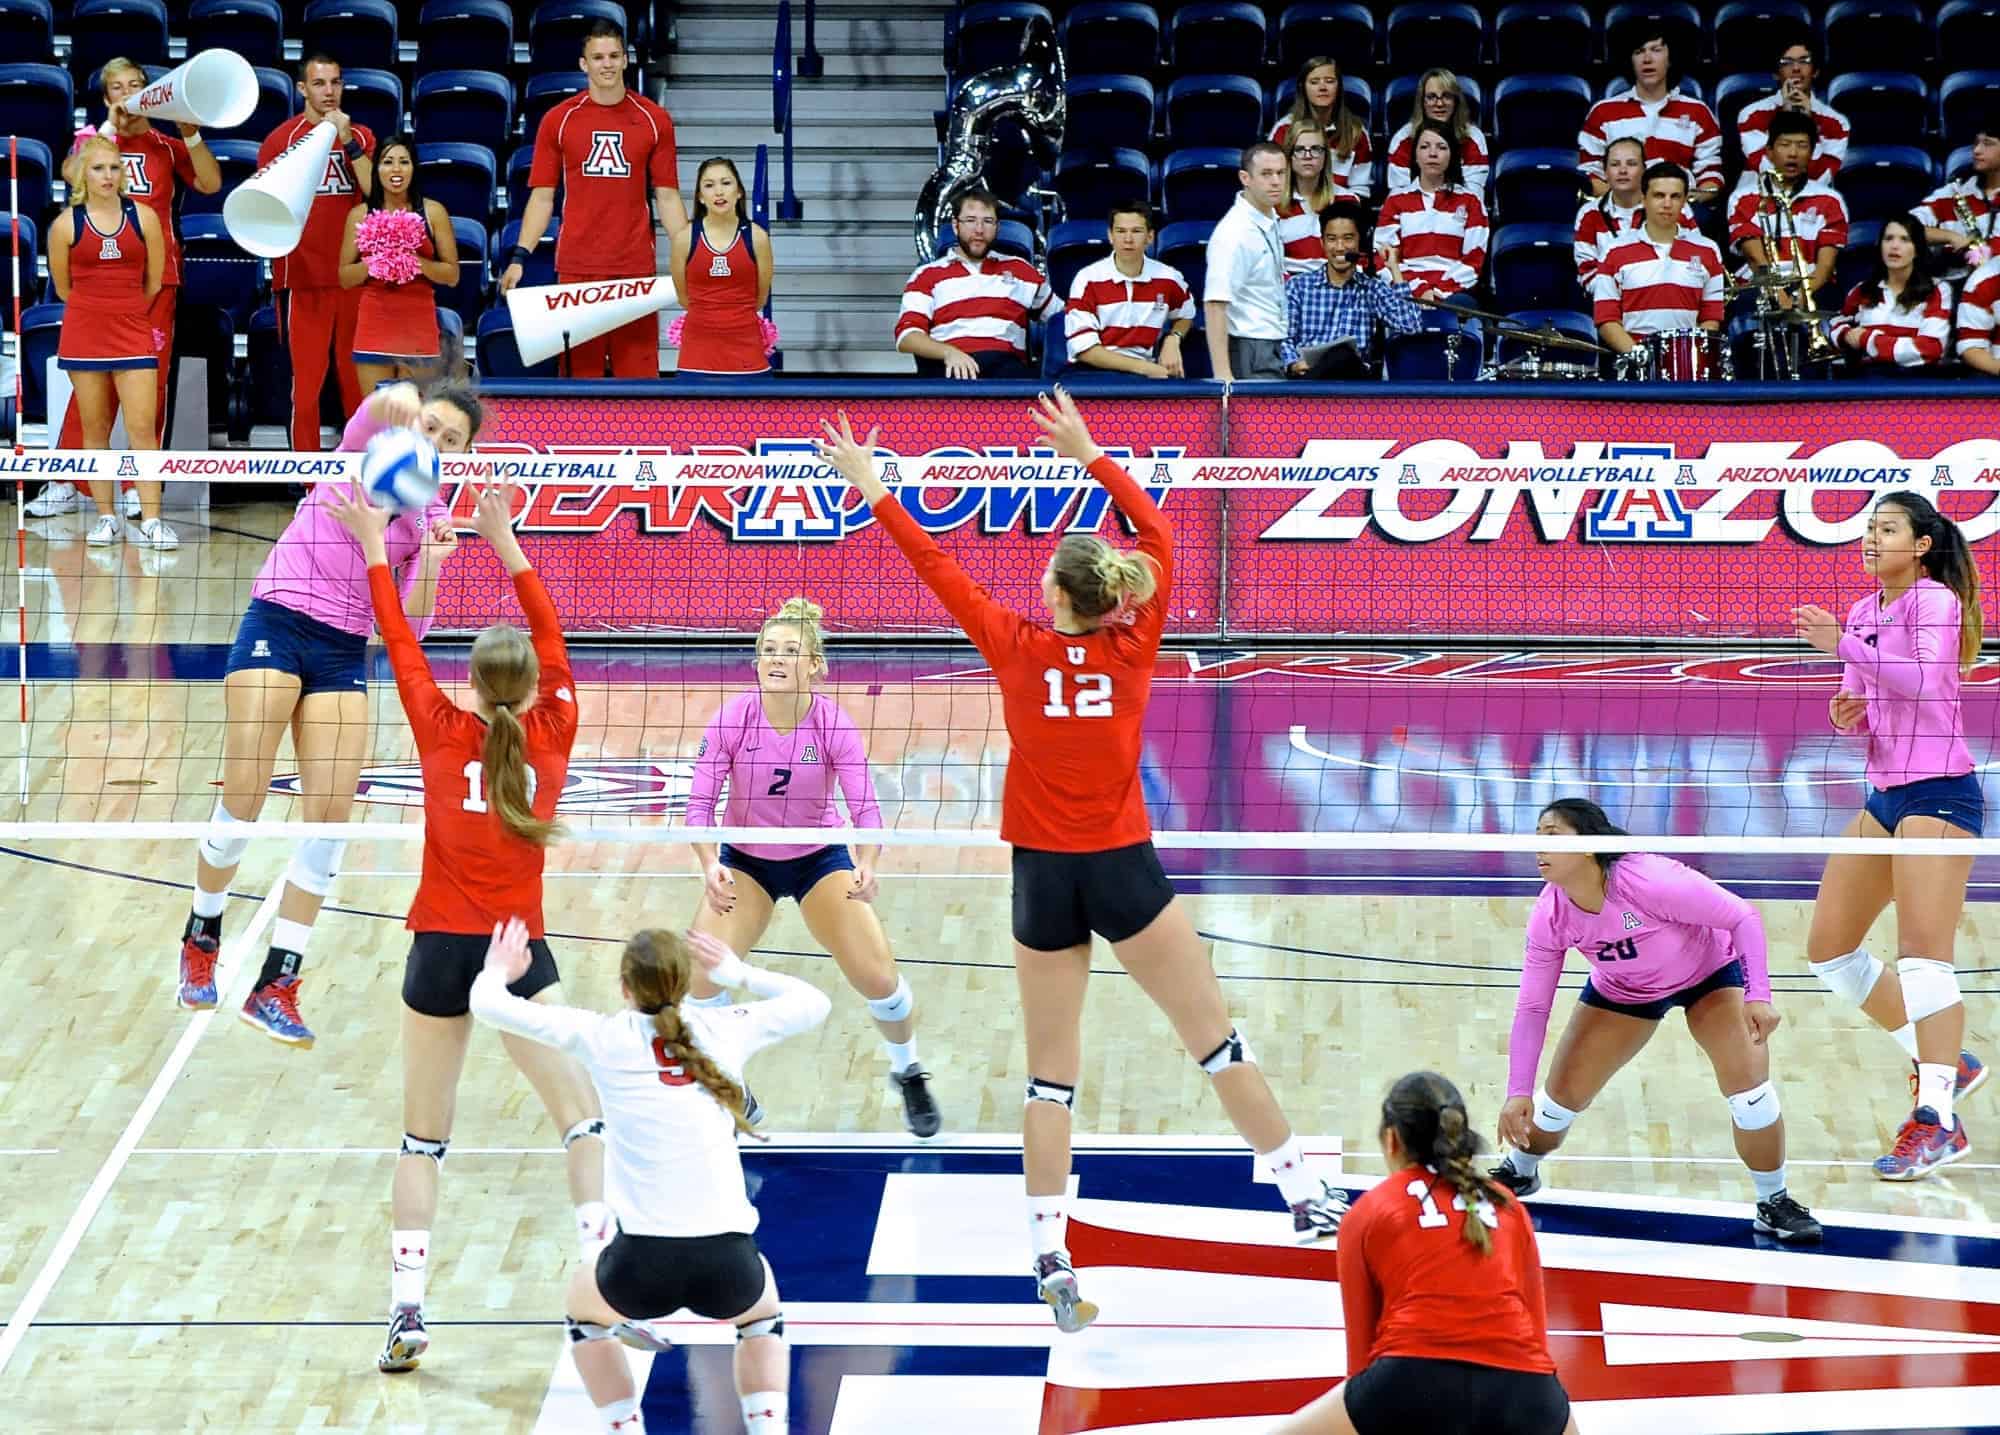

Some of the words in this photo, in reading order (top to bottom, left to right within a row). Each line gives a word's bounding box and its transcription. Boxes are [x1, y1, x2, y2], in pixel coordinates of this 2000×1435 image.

[139, 83, 174, 112] ARIZONA
[582, 131, 631, 177] A
[316, 150, 354, 195] A
[100, 239, 122, 259] A
[545, 278, 657, 311] ARIZONA
[1043, 667, 1114, 717] 12
[800, 745, 818, 761] A
[767, 768, 792, 796] 2
[1622, 911, 1642, 930] A
[1596, 936, 1639, 962] 20
